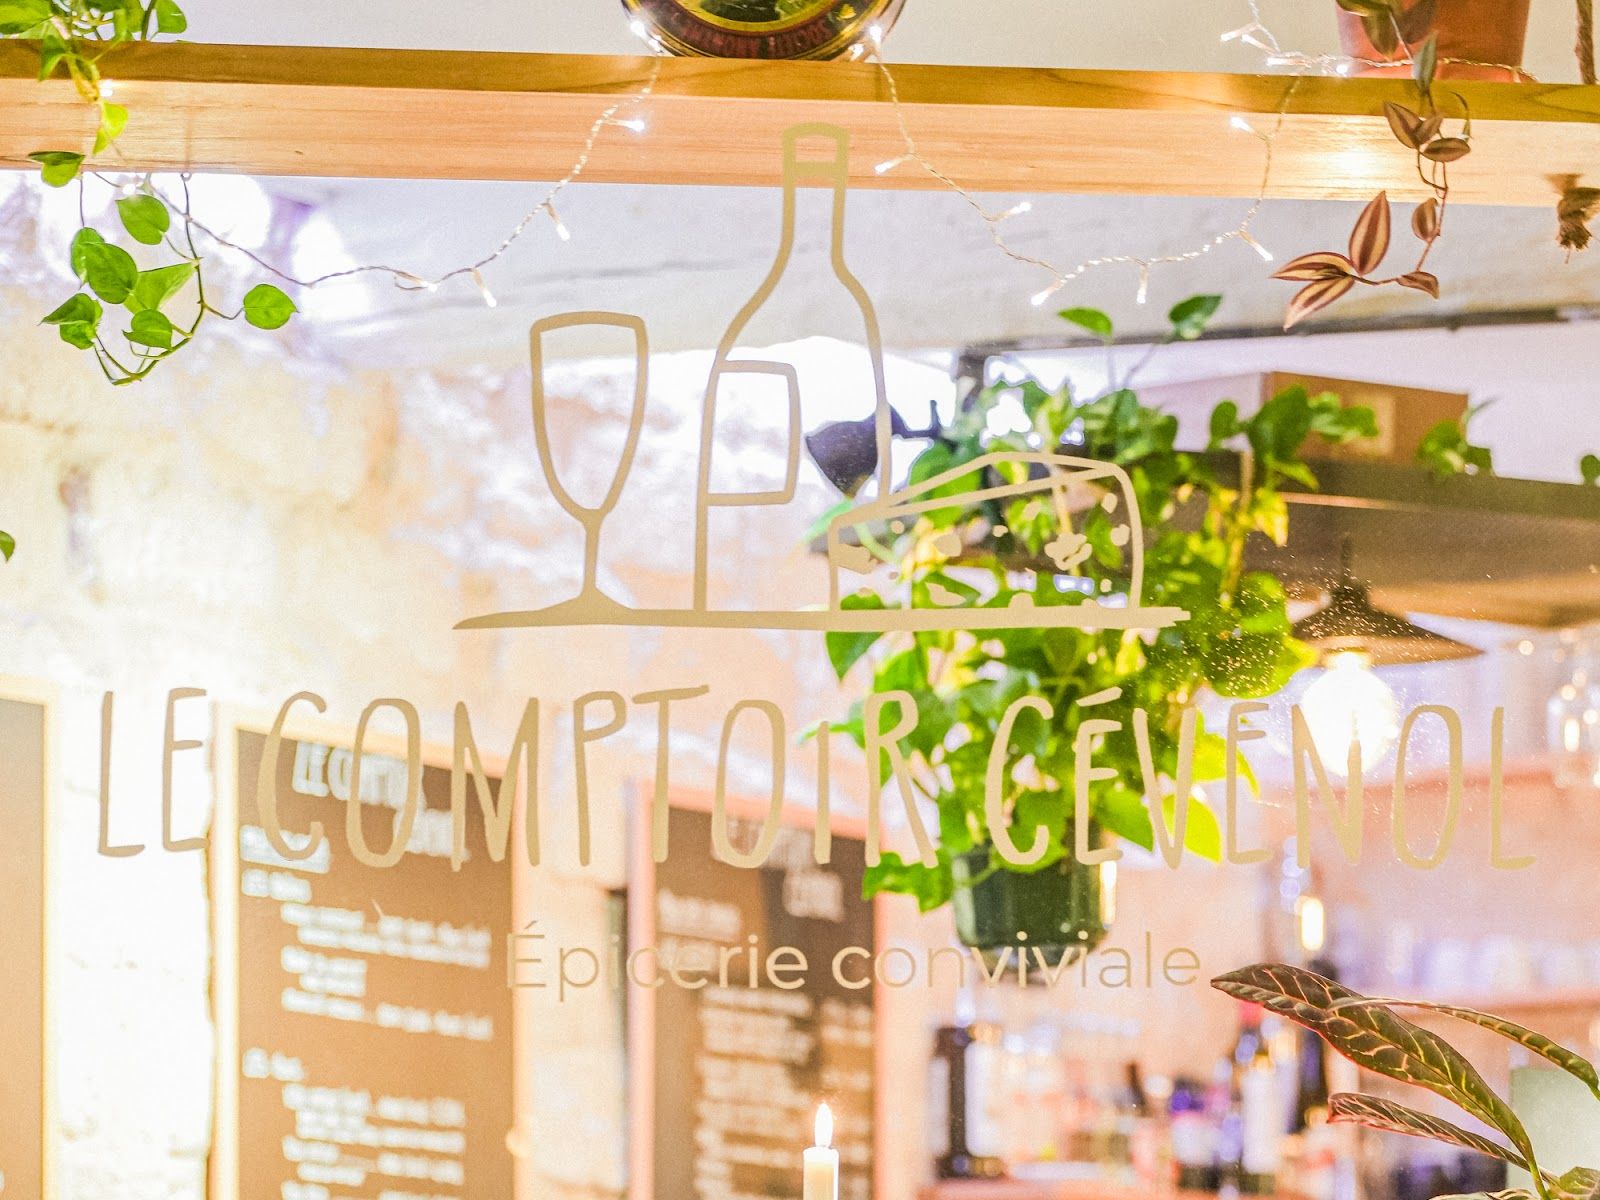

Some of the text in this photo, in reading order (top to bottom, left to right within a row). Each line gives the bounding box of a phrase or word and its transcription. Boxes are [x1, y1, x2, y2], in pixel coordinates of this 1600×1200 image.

[98, 684, 1538, 872] LE COMPTOIR CÉVENOL
[506, 920, 809, 1003] Épicerie
[831, 930, 1201, 990] conviviale
